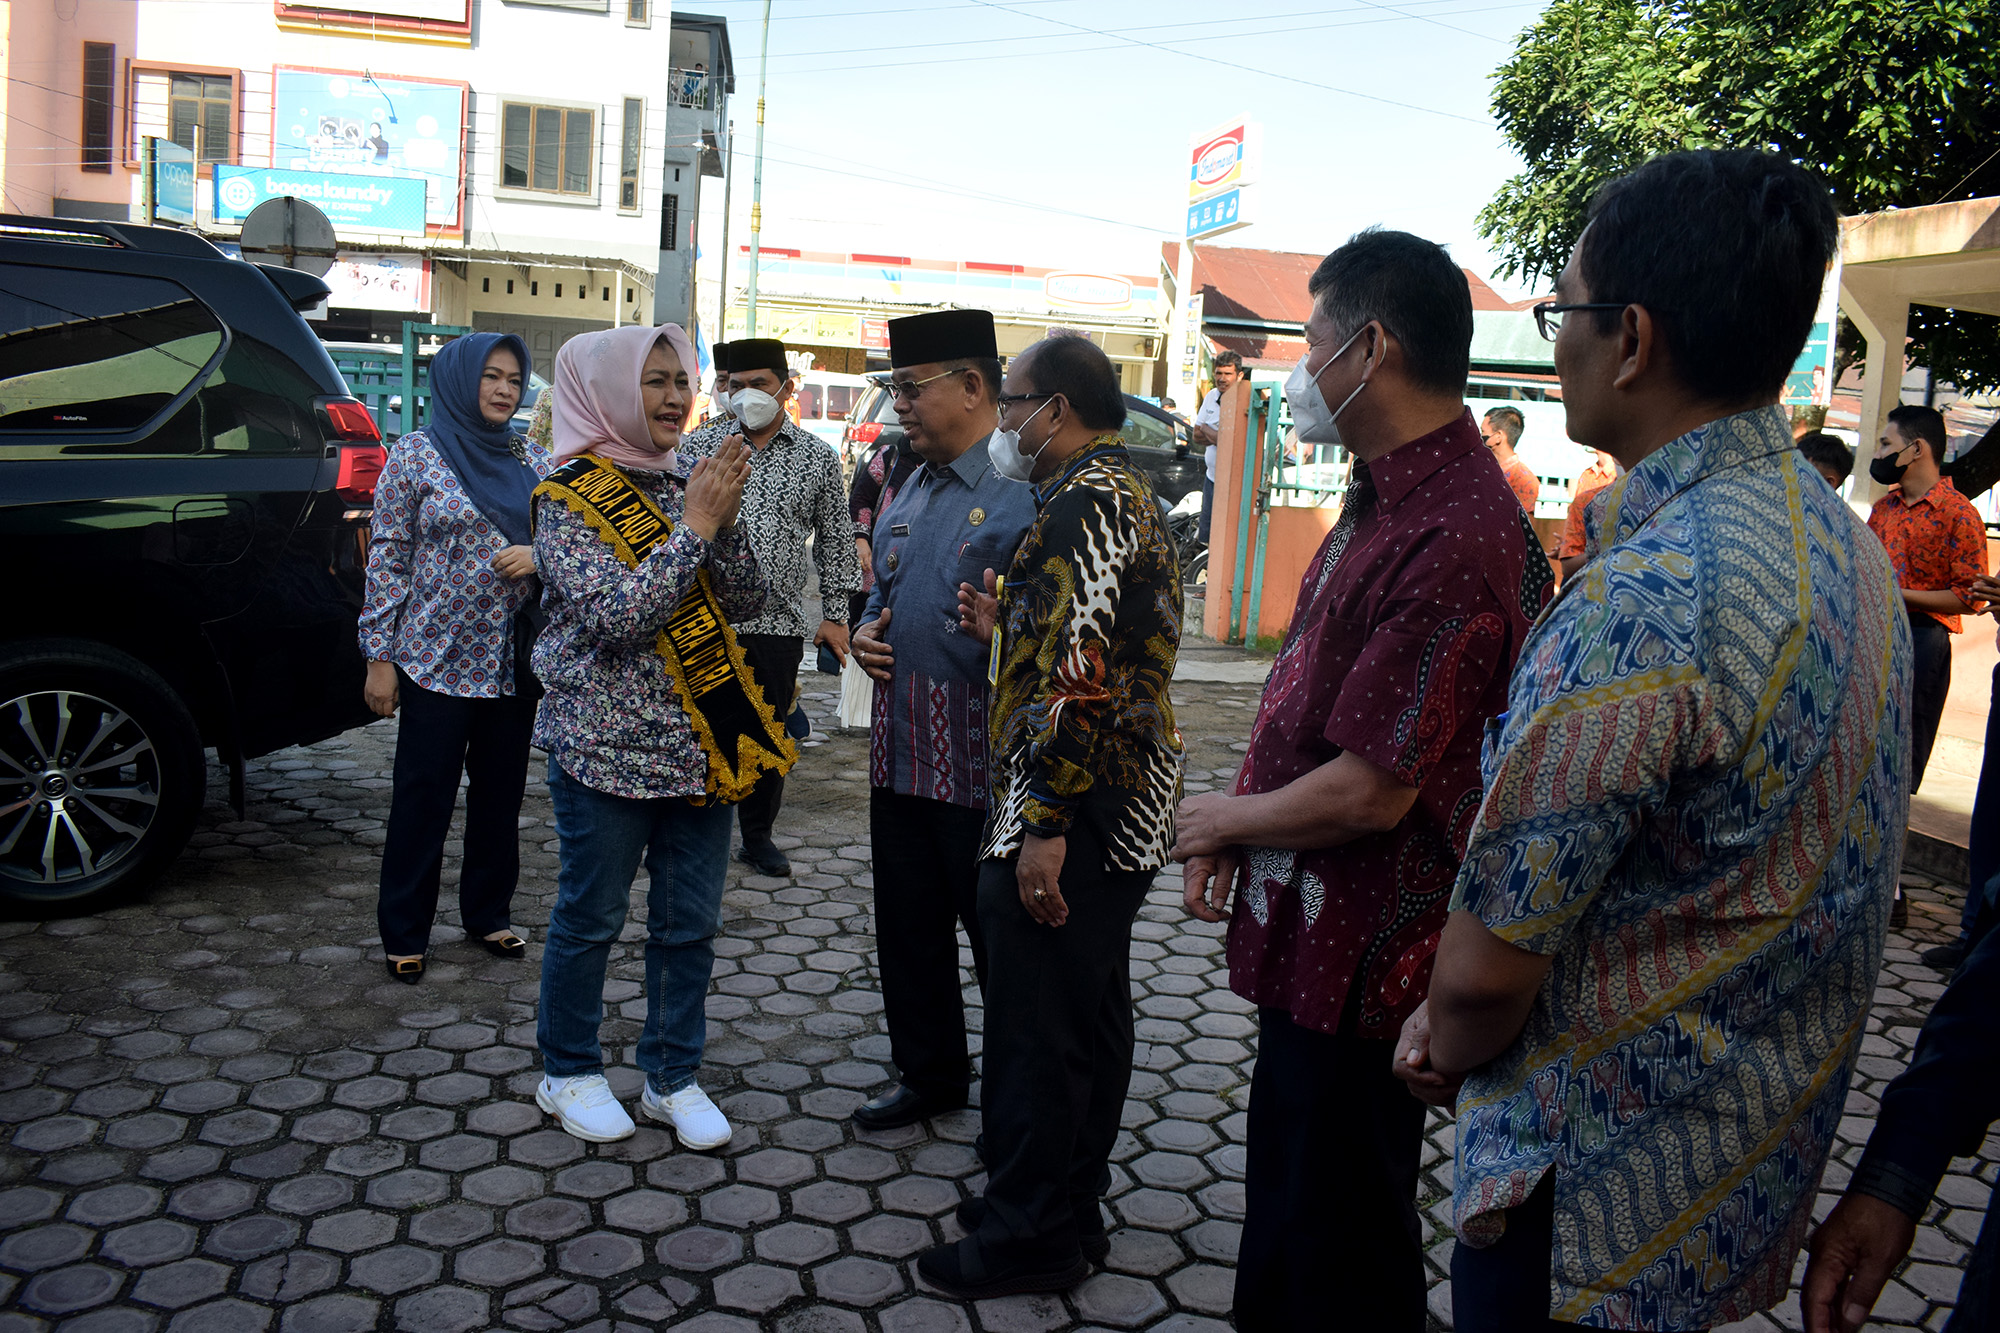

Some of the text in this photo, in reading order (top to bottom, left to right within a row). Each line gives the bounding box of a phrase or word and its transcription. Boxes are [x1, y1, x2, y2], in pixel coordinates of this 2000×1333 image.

[164, 162, 189, 188] oppo
[1200, 150, 1235, 177] Indomaret
[265, 176, 393, 206] bagas laundry
[1055, 280, 1125, 297] Indmaret
[568, 468, 662, 545] BUNDA PAUD
[682, 640, 735, 699] UTARA
